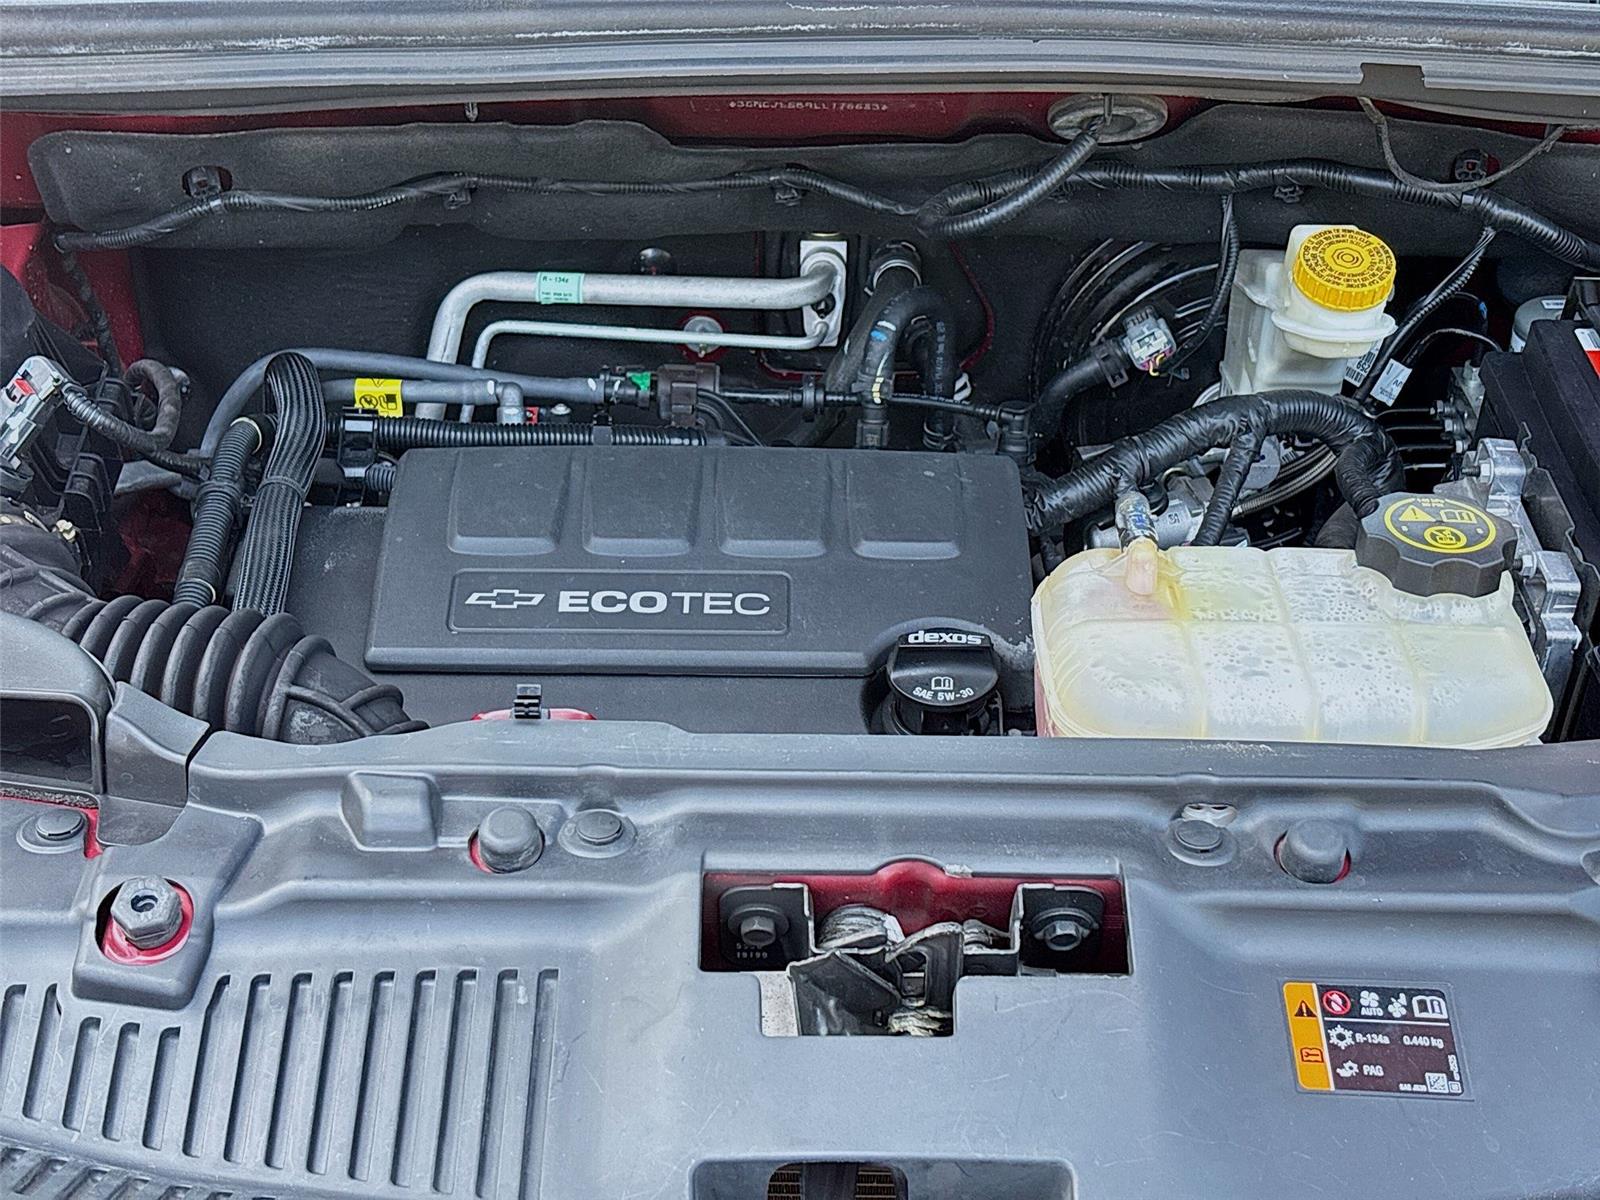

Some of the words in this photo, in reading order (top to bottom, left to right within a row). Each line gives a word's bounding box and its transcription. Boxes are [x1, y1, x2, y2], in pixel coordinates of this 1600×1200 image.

[558, 590, 771, 615] ECOTEC
[908, 630, 985, 644] dexos
[912, 686, 934, 700] SAE
[937, 687, 975, 701] 5W-30
[1360, 1006, 1384, 1017] AUTO
[1355, 1032, 1390, 1045] R-134a
[1430, 1036, 1445, 1049] kg
[1362, 1064, 1385, 1077] PAG
